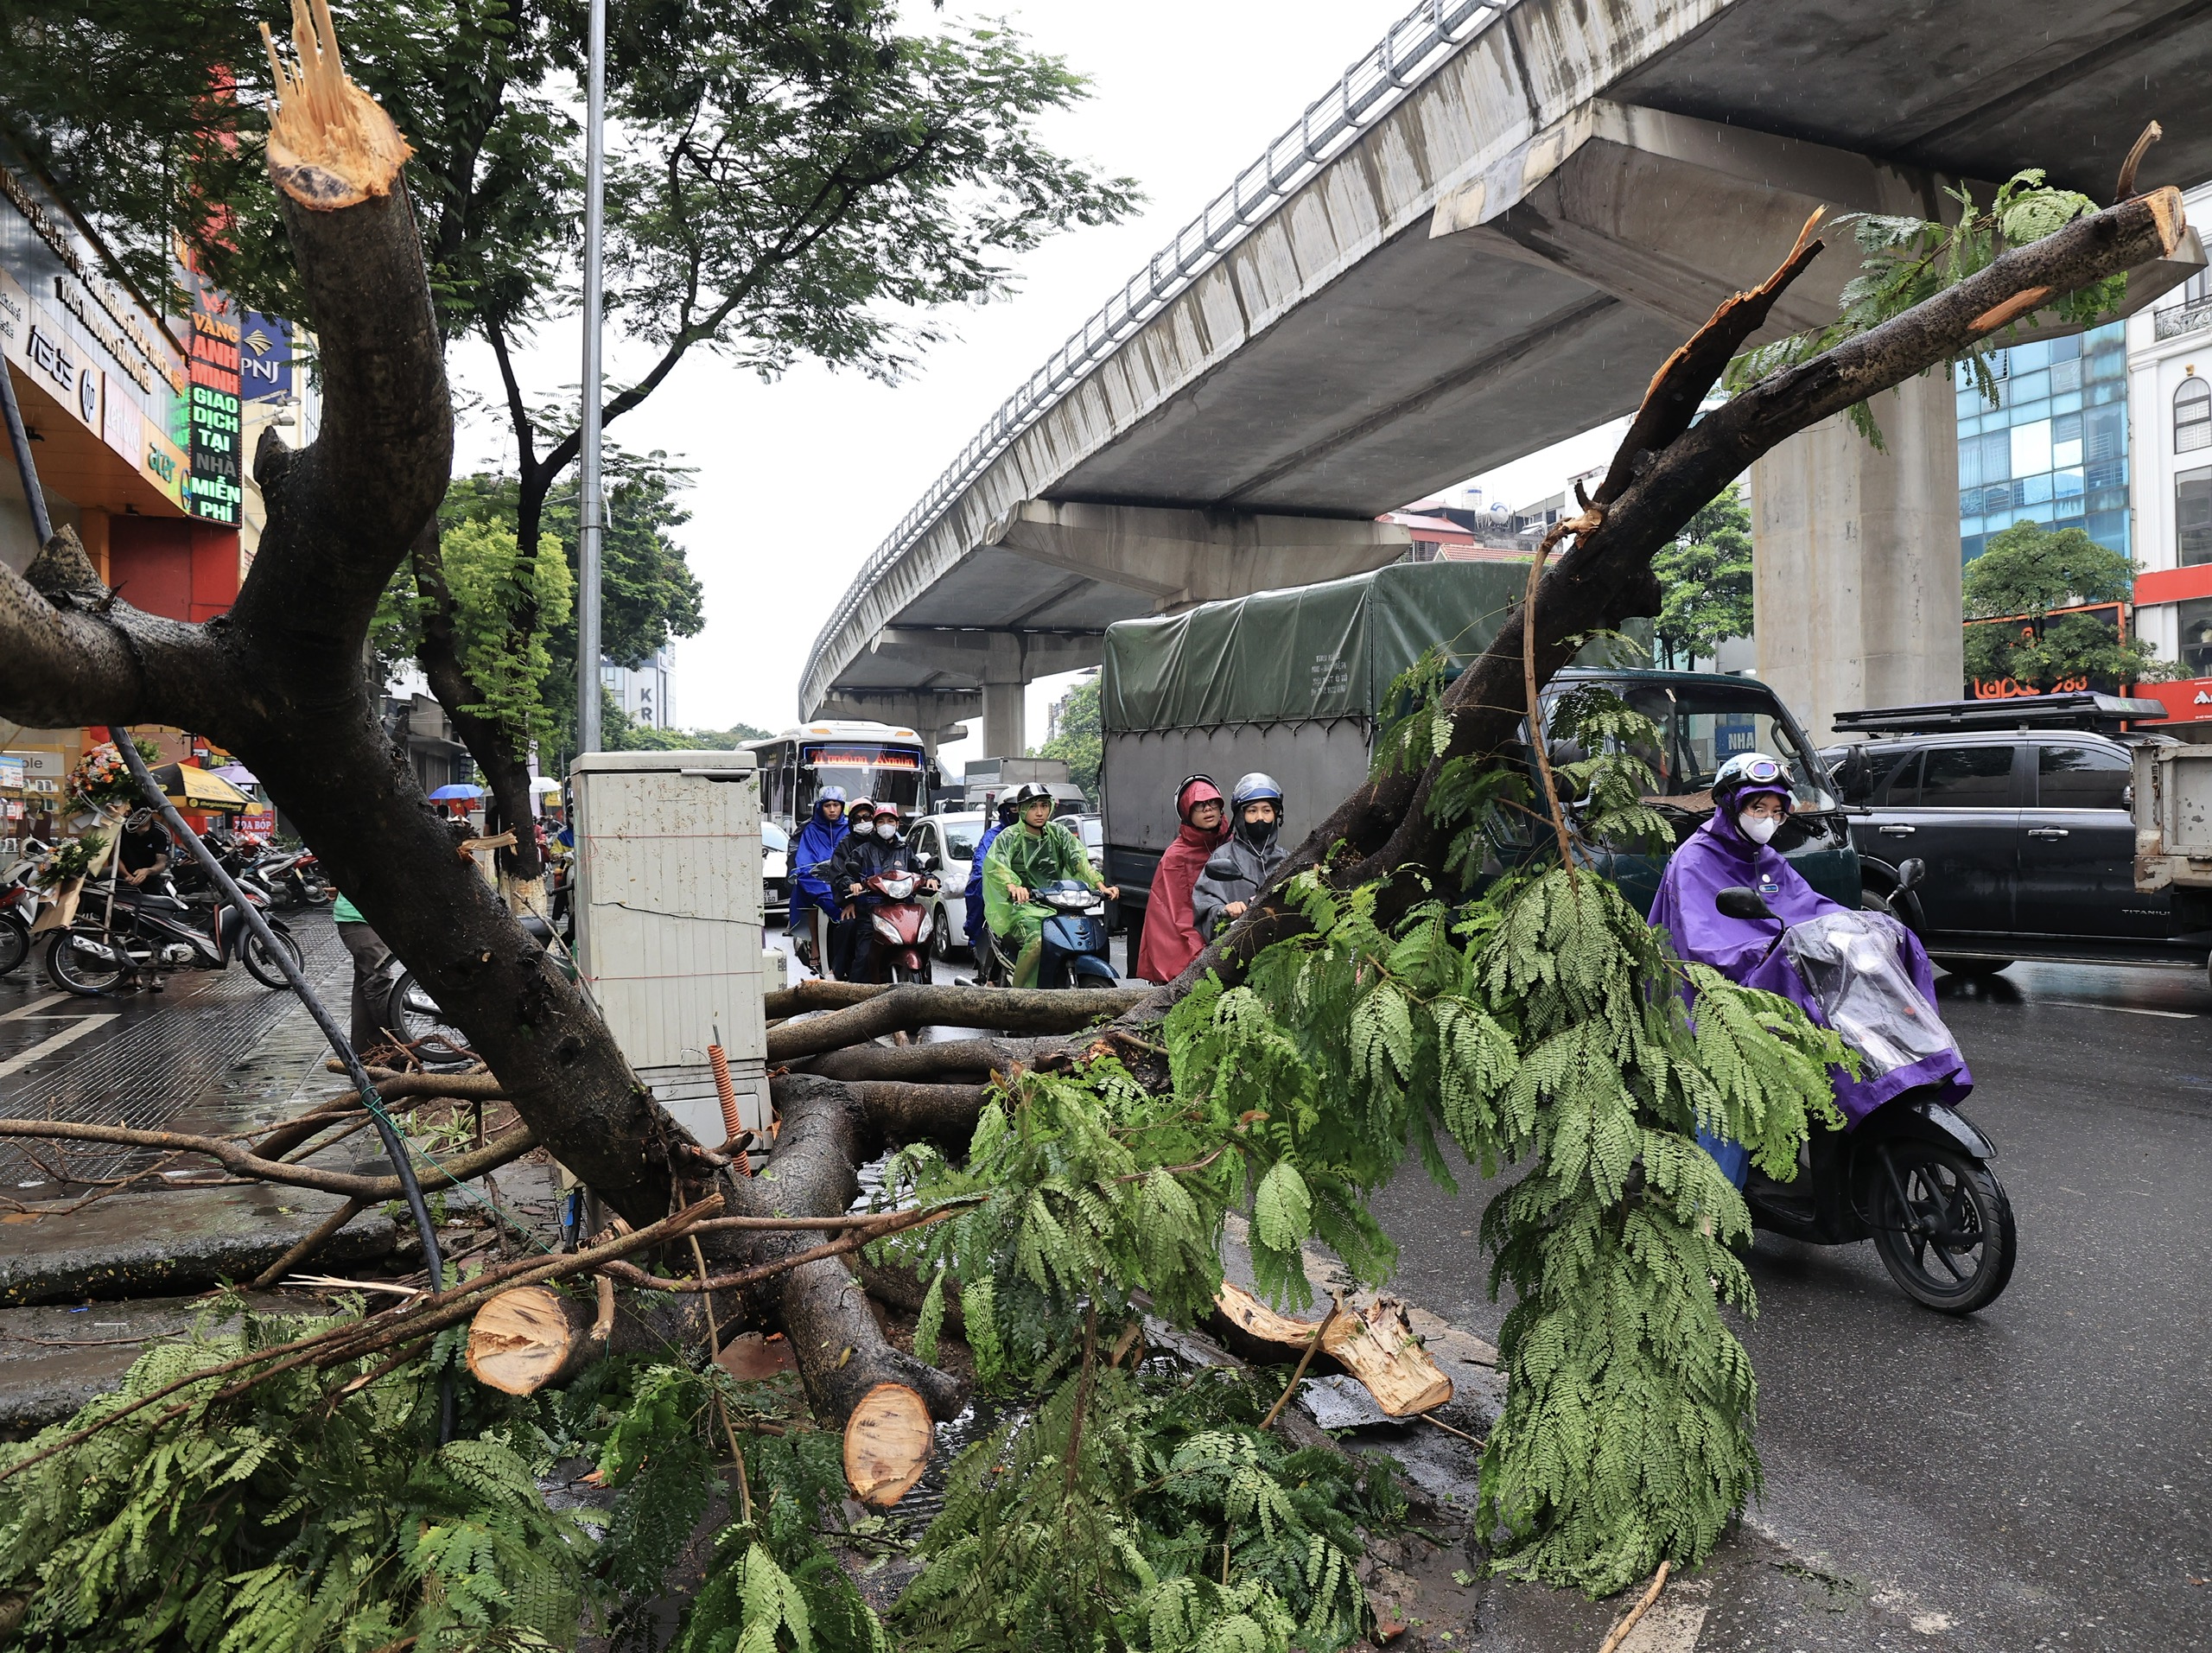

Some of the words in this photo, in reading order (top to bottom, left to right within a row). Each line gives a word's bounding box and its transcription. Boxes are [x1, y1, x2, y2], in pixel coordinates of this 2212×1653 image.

[60, 277, 83, 316] 100%
[82, 299, 118, 355] WINDOWS
[192, 312, 240, 343] VÀNG
[28, 325, 74, 391] ASUS
[192, 334, 238, 371] ANH
[192, 360, 238, 395] MINH
[241, 357, 280, 384] PNJ
[82, 369, 95, 424] hp
[193, 387, 238, 414] GIAO
[193, 405, 238, 434] DỊCH
[198, 428, 230, 454] TẠI
[149, 442, 176, 483] acer
[196, 453, 237, 477] NHÀ
[191, 475, 241, 503] MIỄN
[200, 501, 232, 523] PHÍ
[1728, 732, 1755, 750] NHA
[254, 818, 271, 830] BÓP
